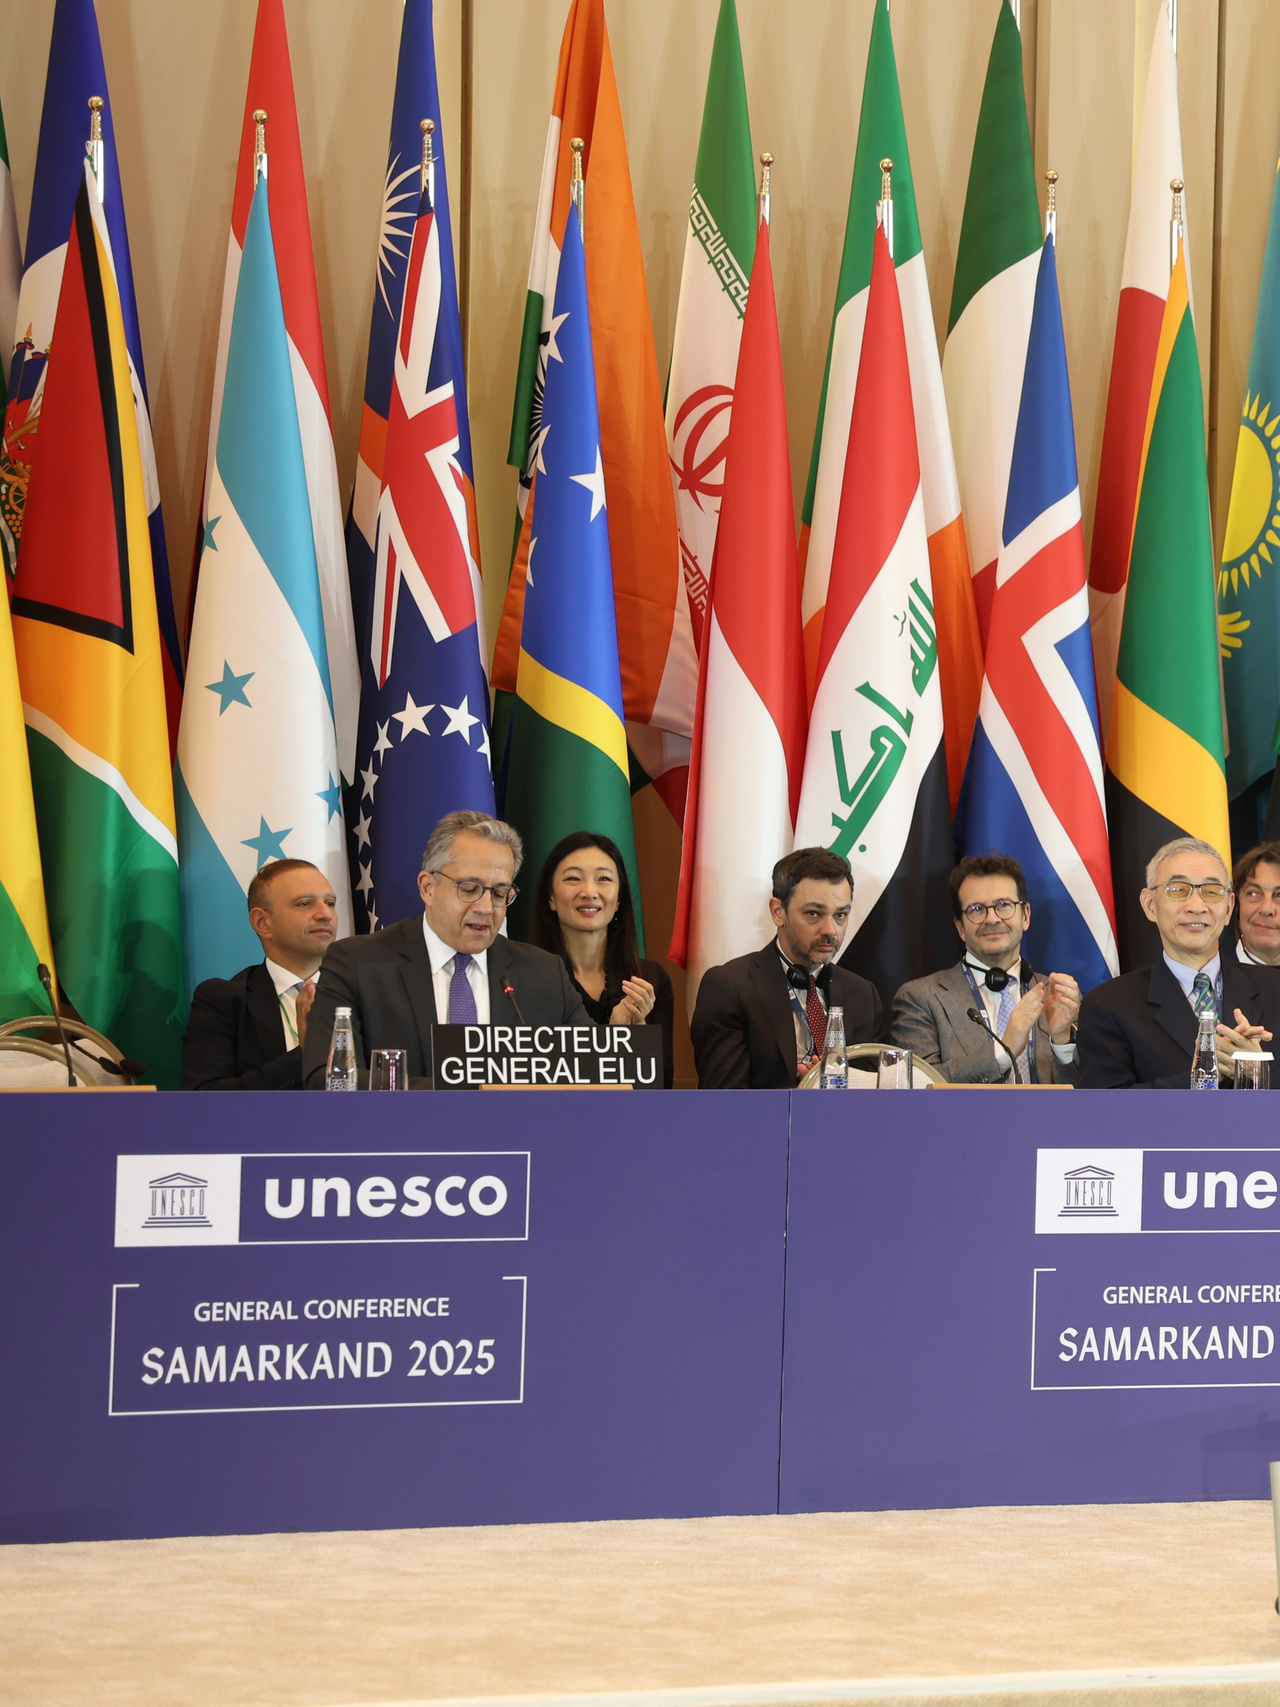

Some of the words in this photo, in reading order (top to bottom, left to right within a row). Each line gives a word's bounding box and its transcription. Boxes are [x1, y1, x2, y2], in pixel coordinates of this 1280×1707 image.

[464, 1026, 634, 1054] DIRECTEUR
[440, 1056, 591, 1085] GENERAL
[598, 1057, 656, 1085] ELU
[151, 1188, 206, 1217] UNESCO
[264, 1175, 508, 1219] unesco
[1065, 1180, 1114, 1207] UNESCO
[193, 1300, 299, 1322] GENERAL
[303, 1297, 450, 1320] CONFERENCE
[1103, 1285, 1193, 1305] GENERAL
[1058, 1325, 1275, 1362] SAMARKAND
[141, 1341, 393, 1385] SAMARKAND
[406, 1339, 495, 1377] 2025
